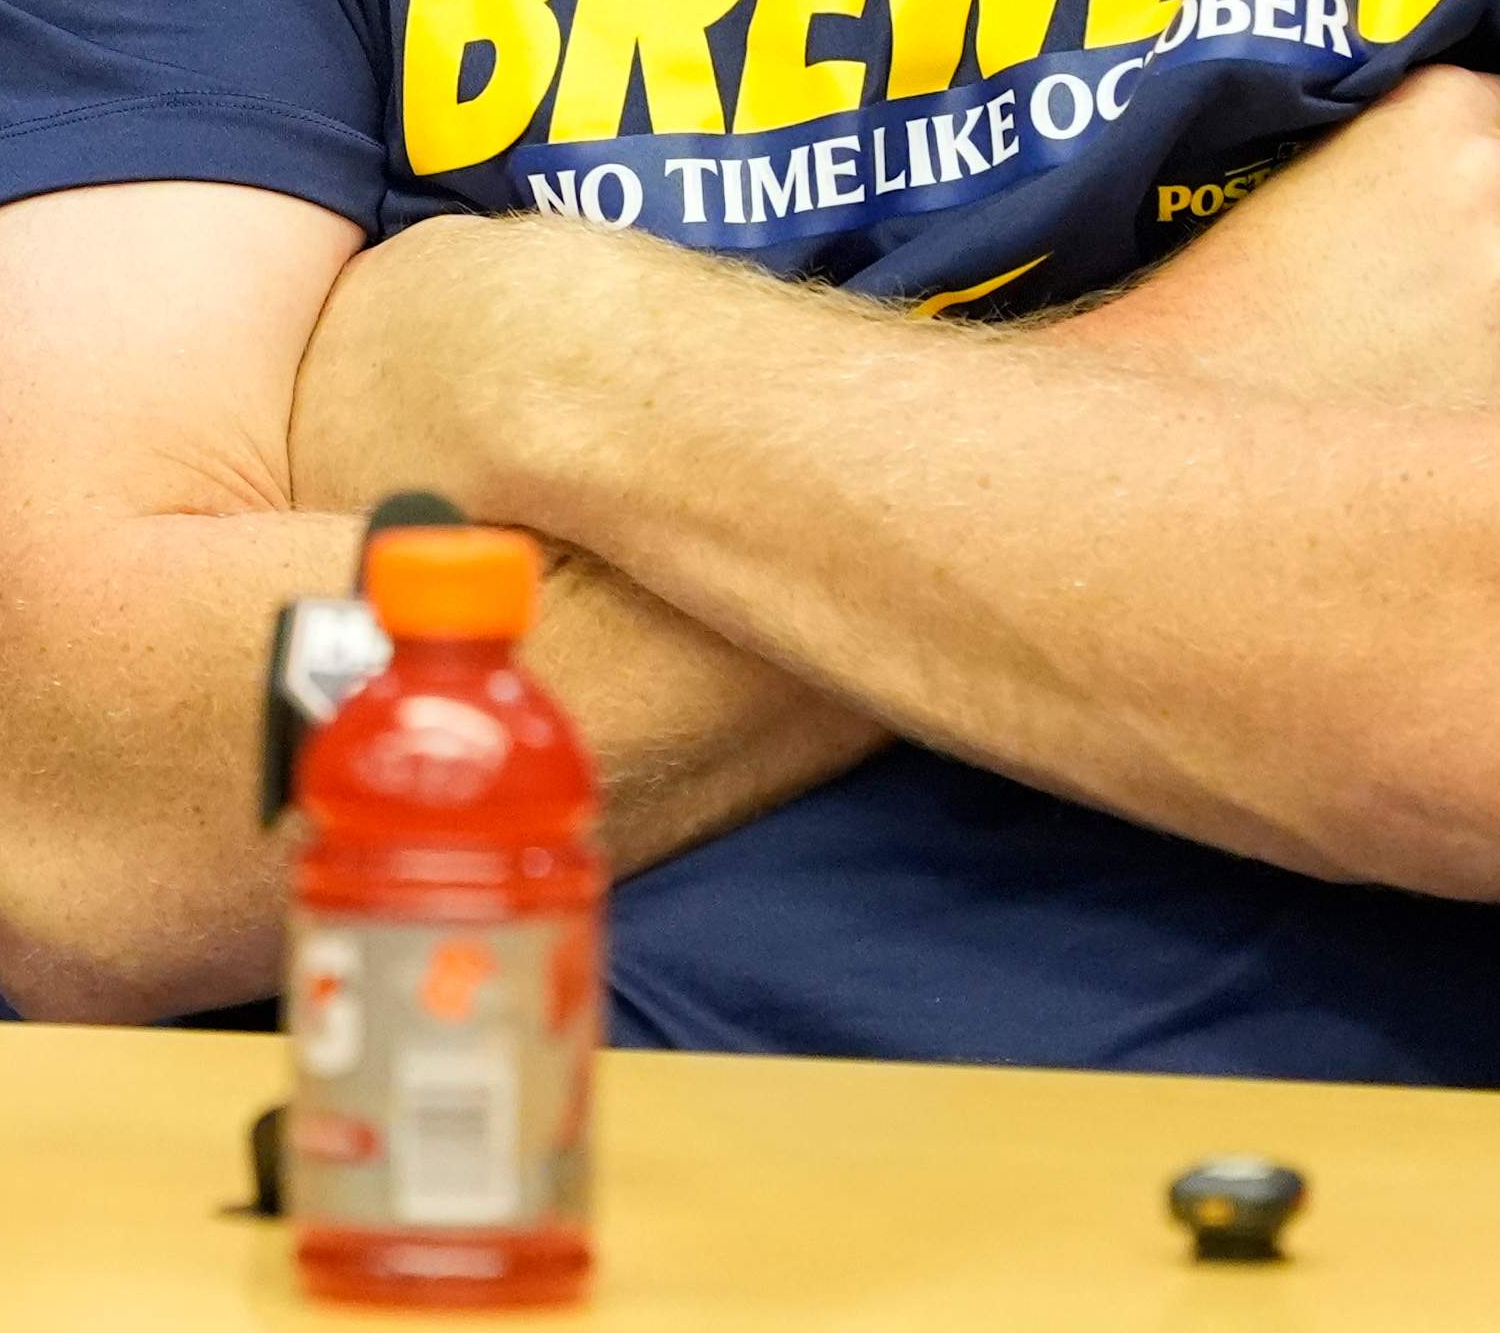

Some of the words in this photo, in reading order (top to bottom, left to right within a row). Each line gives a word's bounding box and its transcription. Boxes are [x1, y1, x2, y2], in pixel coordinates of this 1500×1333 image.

[528, 162, 643, 230] NO
[664, 135, 866, 225] TIME
[872, 87, 1020, 196] LIKE
